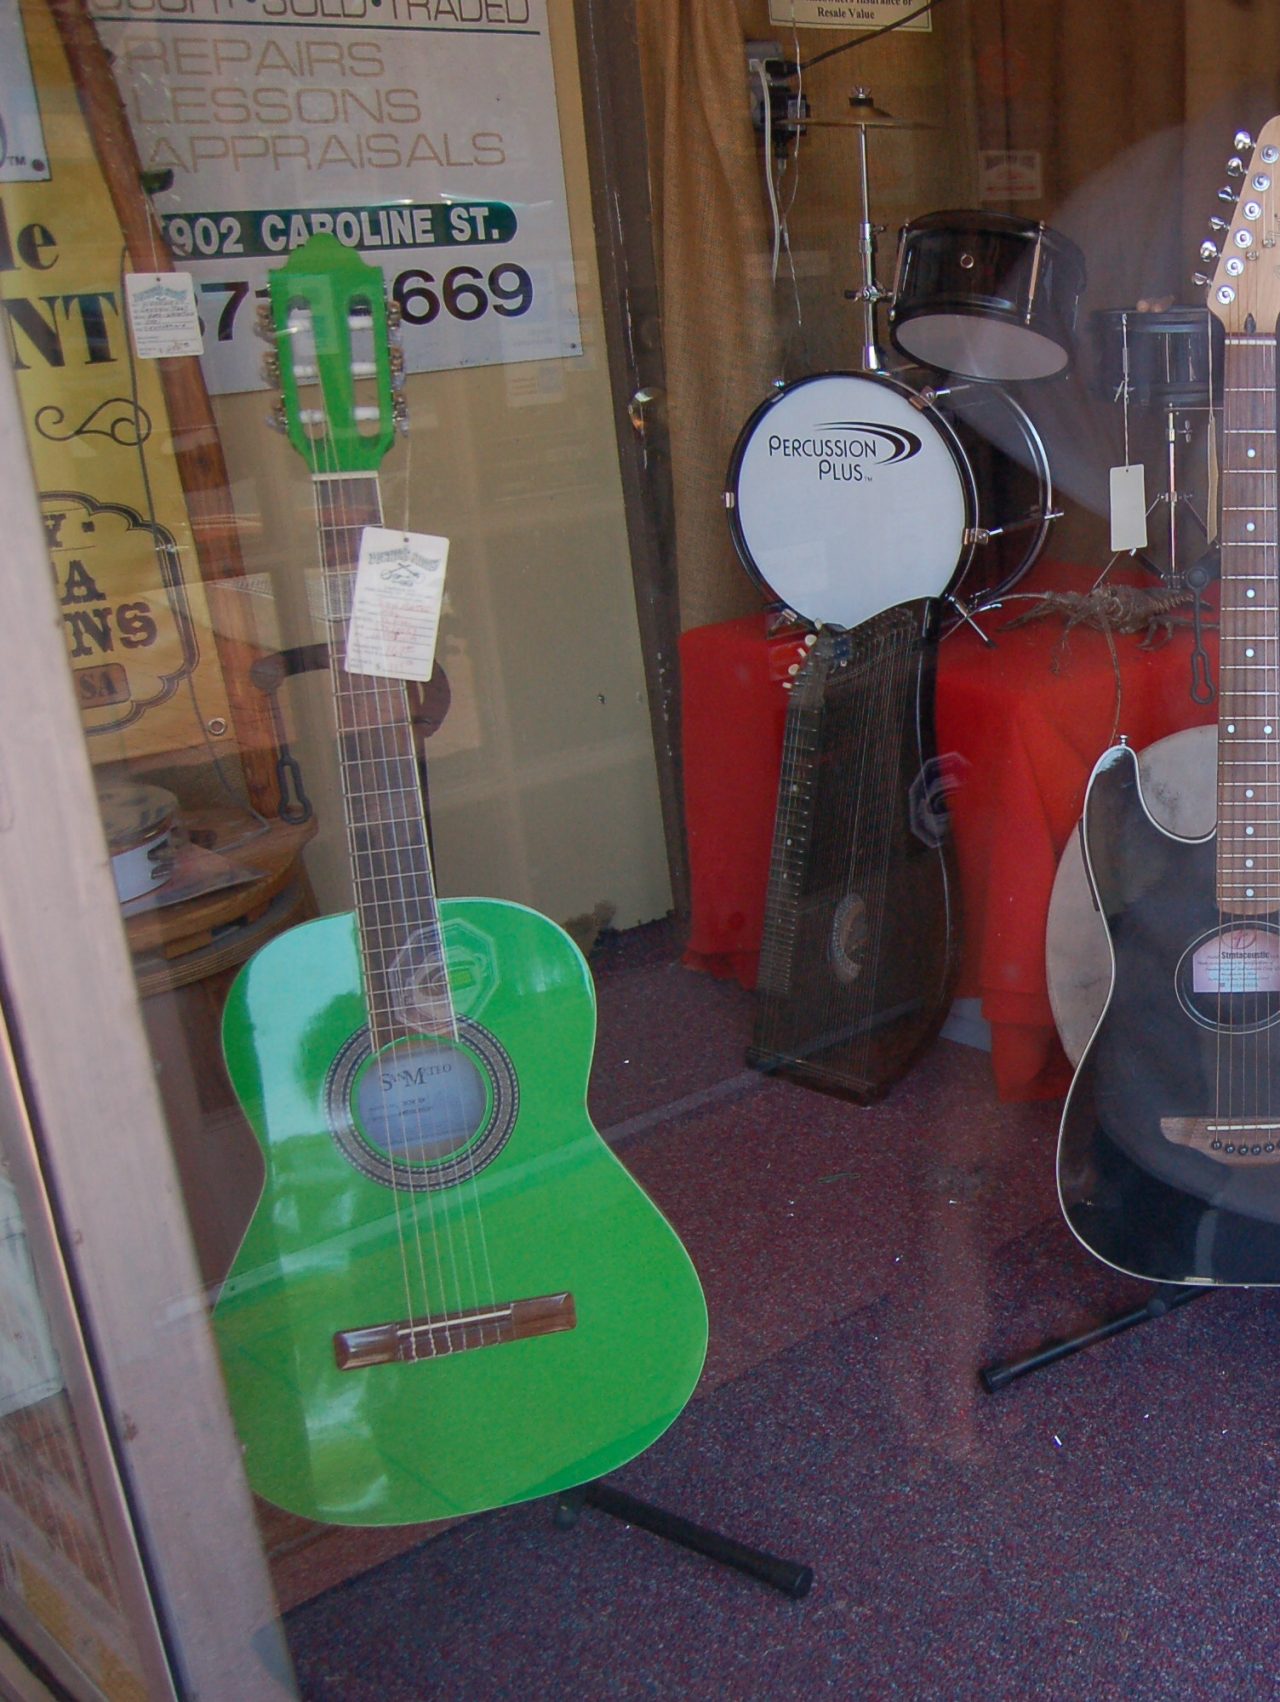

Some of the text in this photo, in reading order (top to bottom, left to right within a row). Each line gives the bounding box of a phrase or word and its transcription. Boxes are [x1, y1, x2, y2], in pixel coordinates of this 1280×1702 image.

[817, 7, 875, 19] Resale Value
[124, 37, 385, 77] REPAIRS
[132, 87, 421, 125] LESSONS
[148, 132, 506, 173] APPRAISALS
[261, 207, 434, 252] CAROLINE
[449, 207, 500, 242] ST.
[768, 434, 877, 459] PERCUSSION
[818, 459, 863, 482] PLUS
